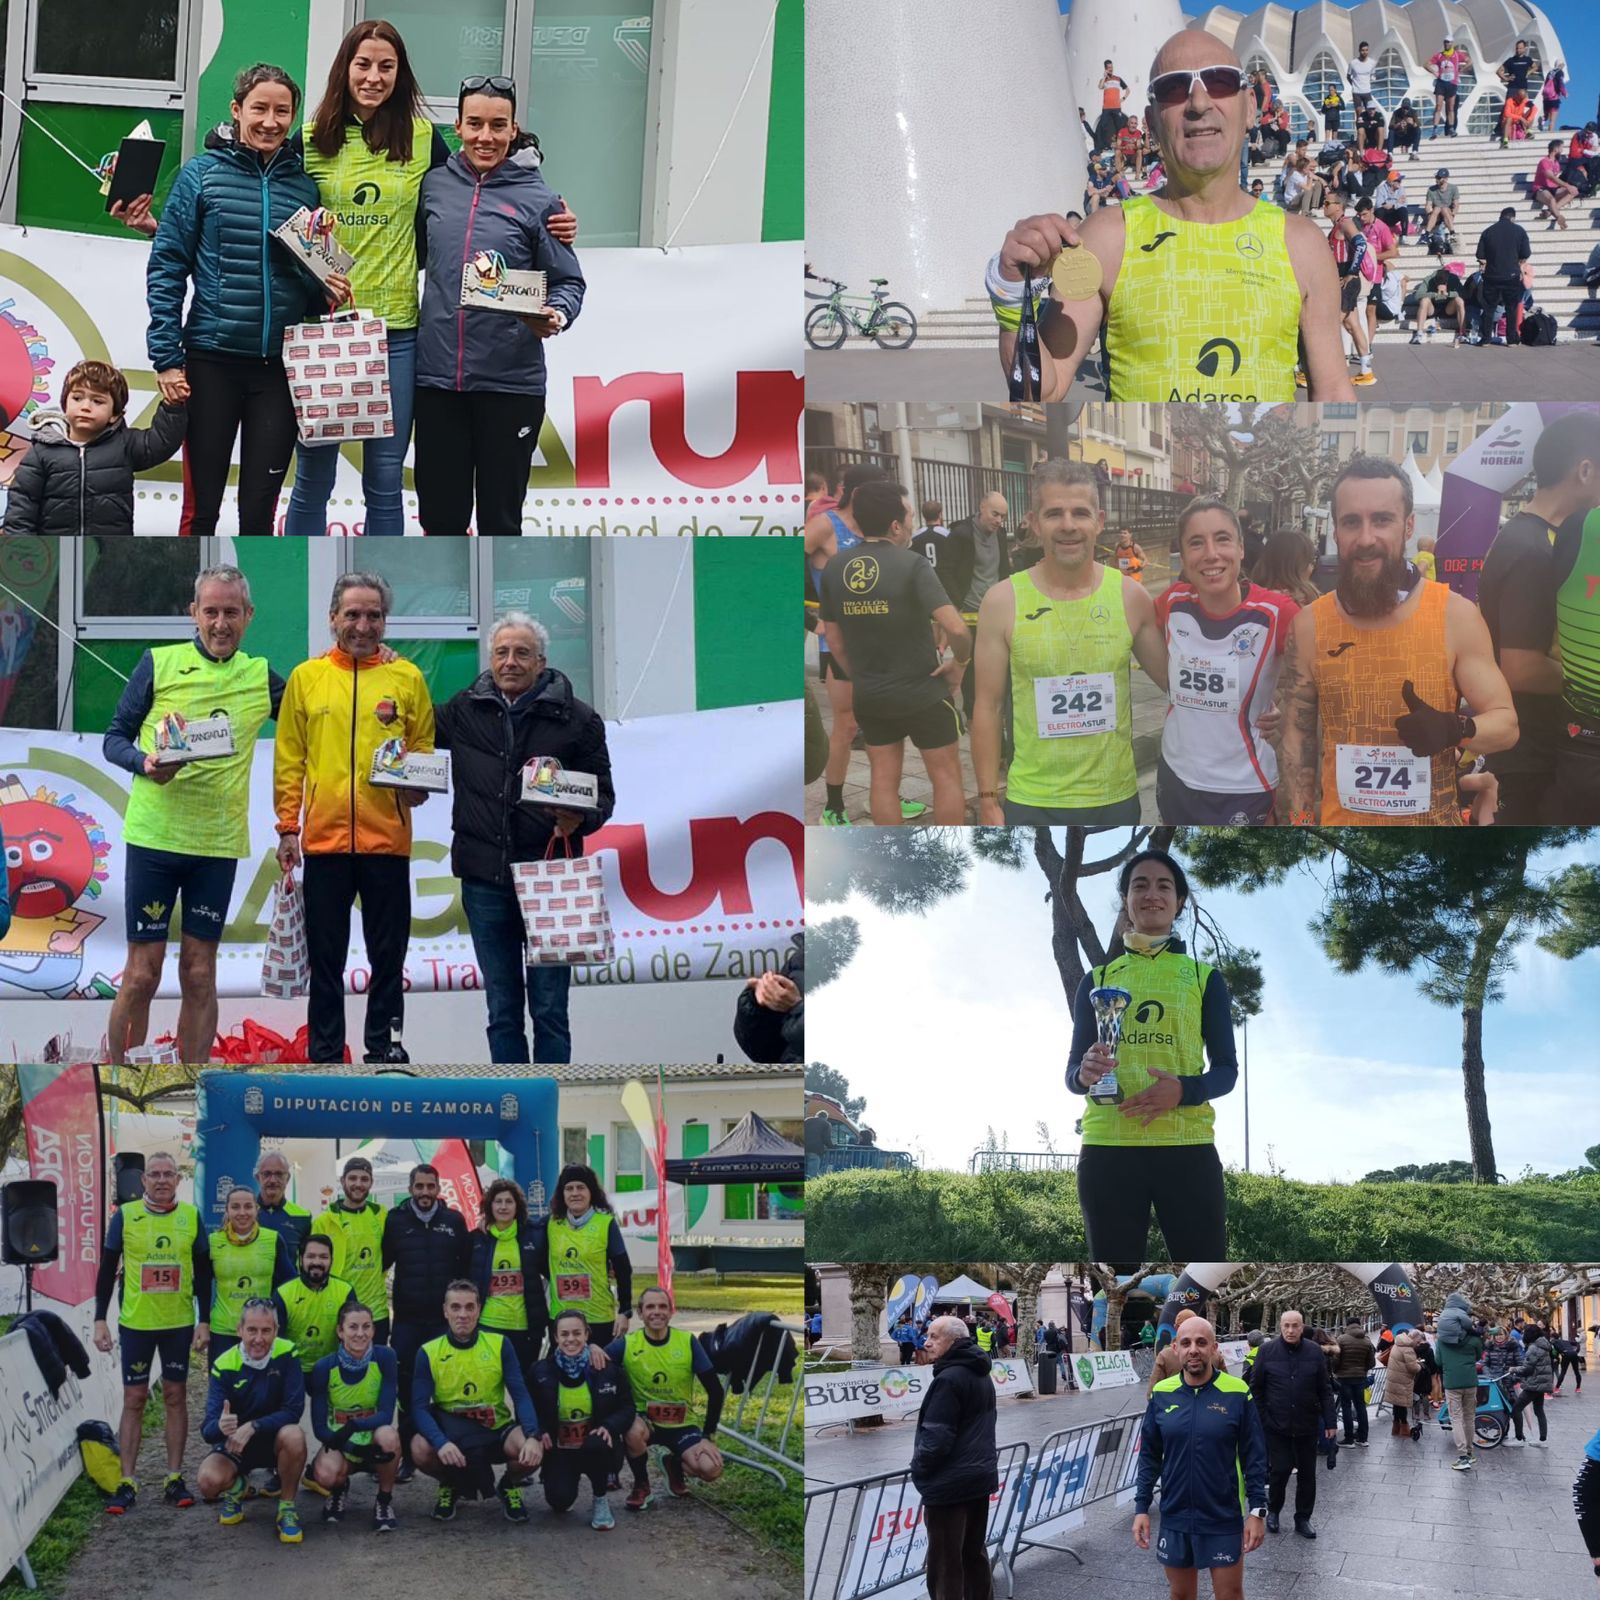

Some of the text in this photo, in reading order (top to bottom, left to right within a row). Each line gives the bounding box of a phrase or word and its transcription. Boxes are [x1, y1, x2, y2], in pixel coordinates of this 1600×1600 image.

[336, 211, 389, 226] Adarsa
[1480, 455, 1524, 466] NOREÑA
[925, 542, 937, 568] 9
[843, 605, 889, 616] LUGONES
[1179, 669, 1224, 694] 258
[1051, 690, 1102, 715] 242
[1175, 693, 1229, 709] ELECTROASTUR
[1047, 718, 1106, 731] ELECTROASTUR
[1381, 751, 1396, 759] KM
[1354, 765, 1412, 790] 274
[1348, 796, 1417, 808] ELECTROASTUR
[650, 945, 691, 982] de
[1119, 1030, 1174, 1046] Adarsa
[273, 1096, 495, 1115] DIPUTACIÓN DE ZAMORA
[152, 1270, 170, 1283] 15
[493, 1275, 517, 1287] 293
[1374, 1282, 1412, 1299] Burgos
[804, 1369, 922, 1407] Burgos
[826, 1379, 869, 1388] Provincia
